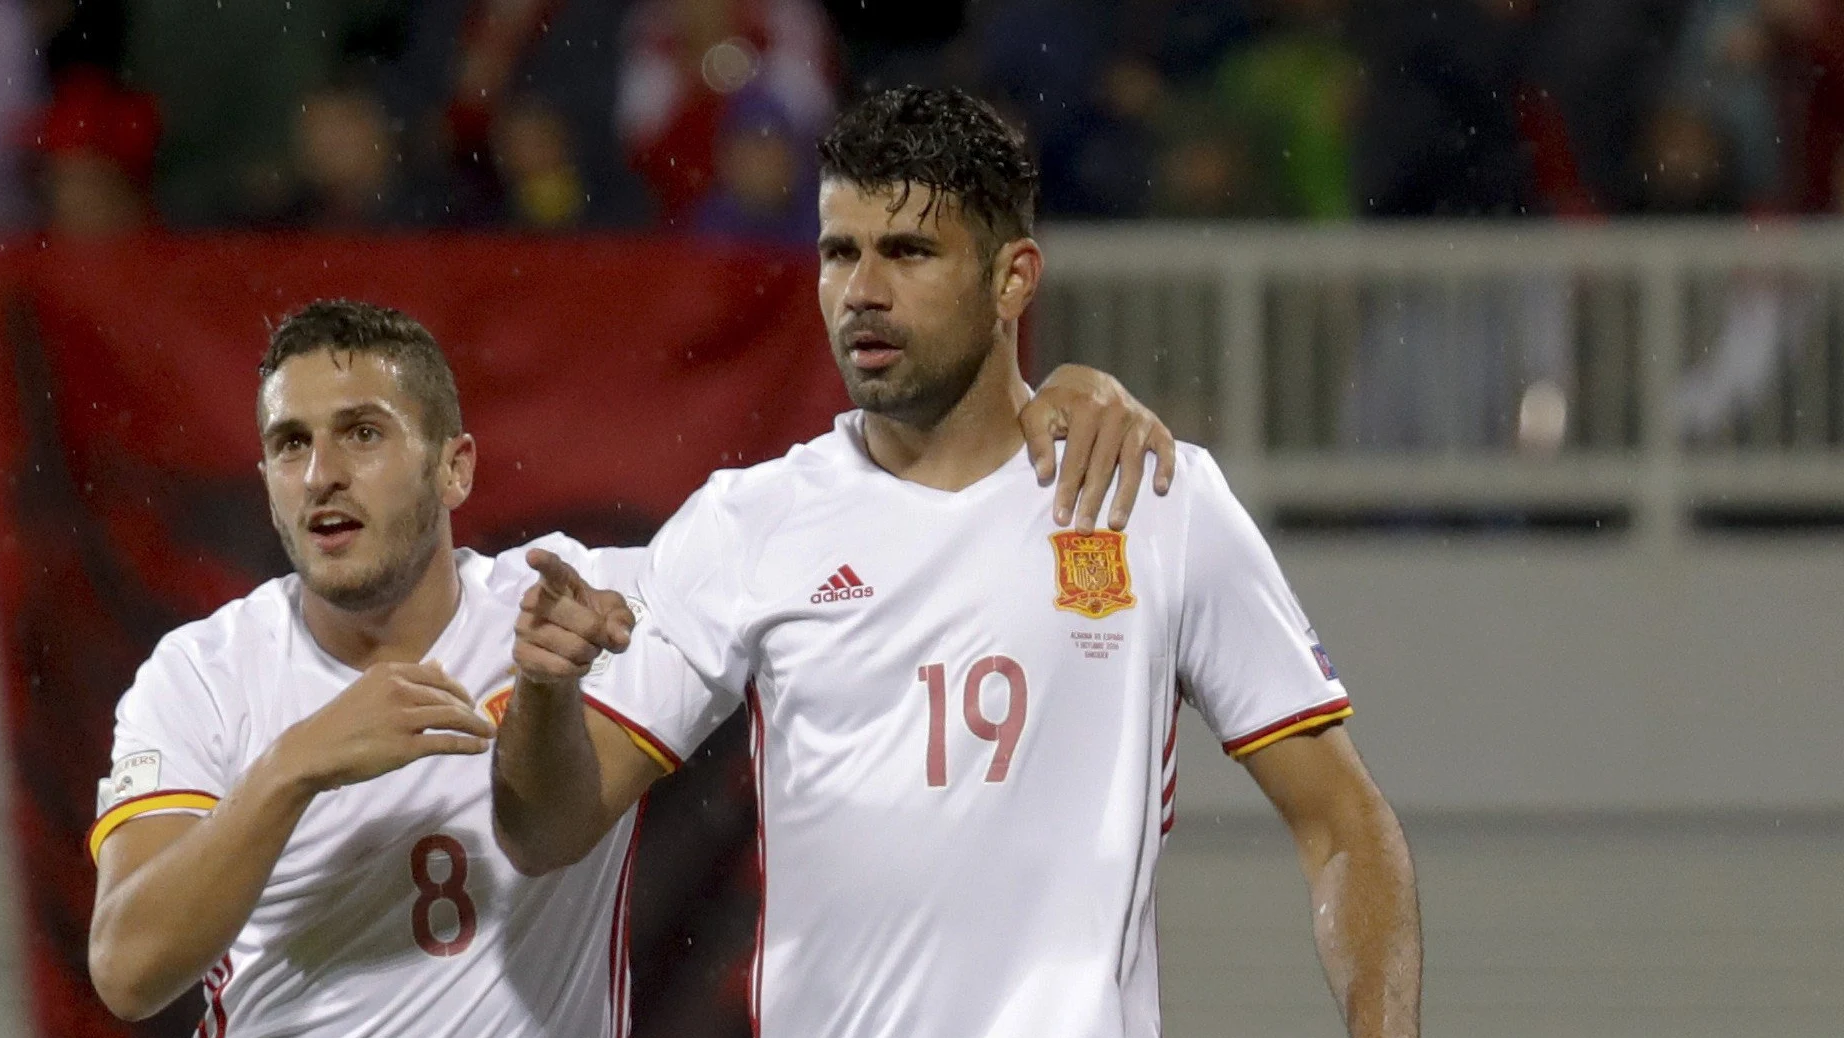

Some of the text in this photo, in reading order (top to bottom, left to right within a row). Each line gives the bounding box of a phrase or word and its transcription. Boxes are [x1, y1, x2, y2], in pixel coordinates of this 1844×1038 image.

[810, 586, 874, 604] adidas
[918, 655, 1028, 787] 19
[410, 833, 477, 957] 8
